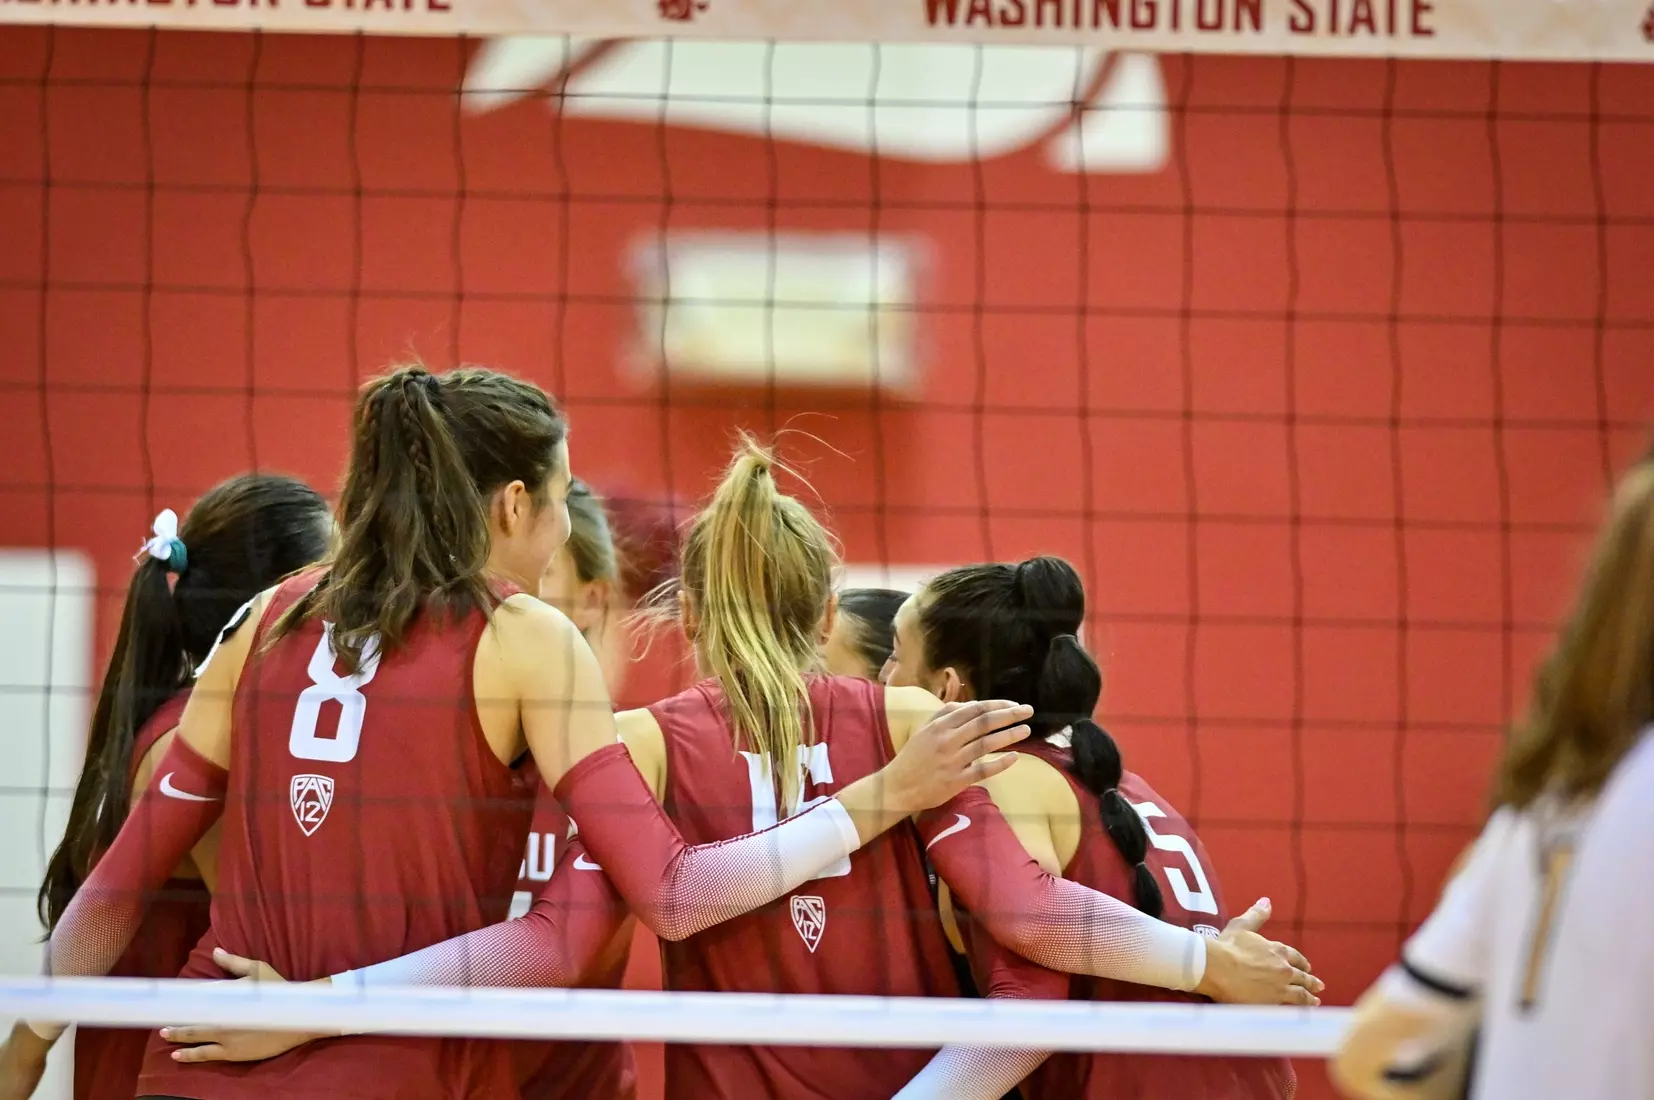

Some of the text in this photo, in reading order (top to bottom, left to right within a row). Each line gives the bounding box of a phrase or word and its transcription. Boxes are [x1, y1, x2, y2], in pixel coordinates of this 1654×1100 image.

[923, 0, 1437, 37] WASHINGTON STATE
[289, 620, 383, 763] 8
[293, 777, 332, 812] PAC
[300, 800, 321, 822] 12
[517, 831, 556, 881] U
[1124, 797, 1219, 916] 5
[802, 919, 818, 940] 12
